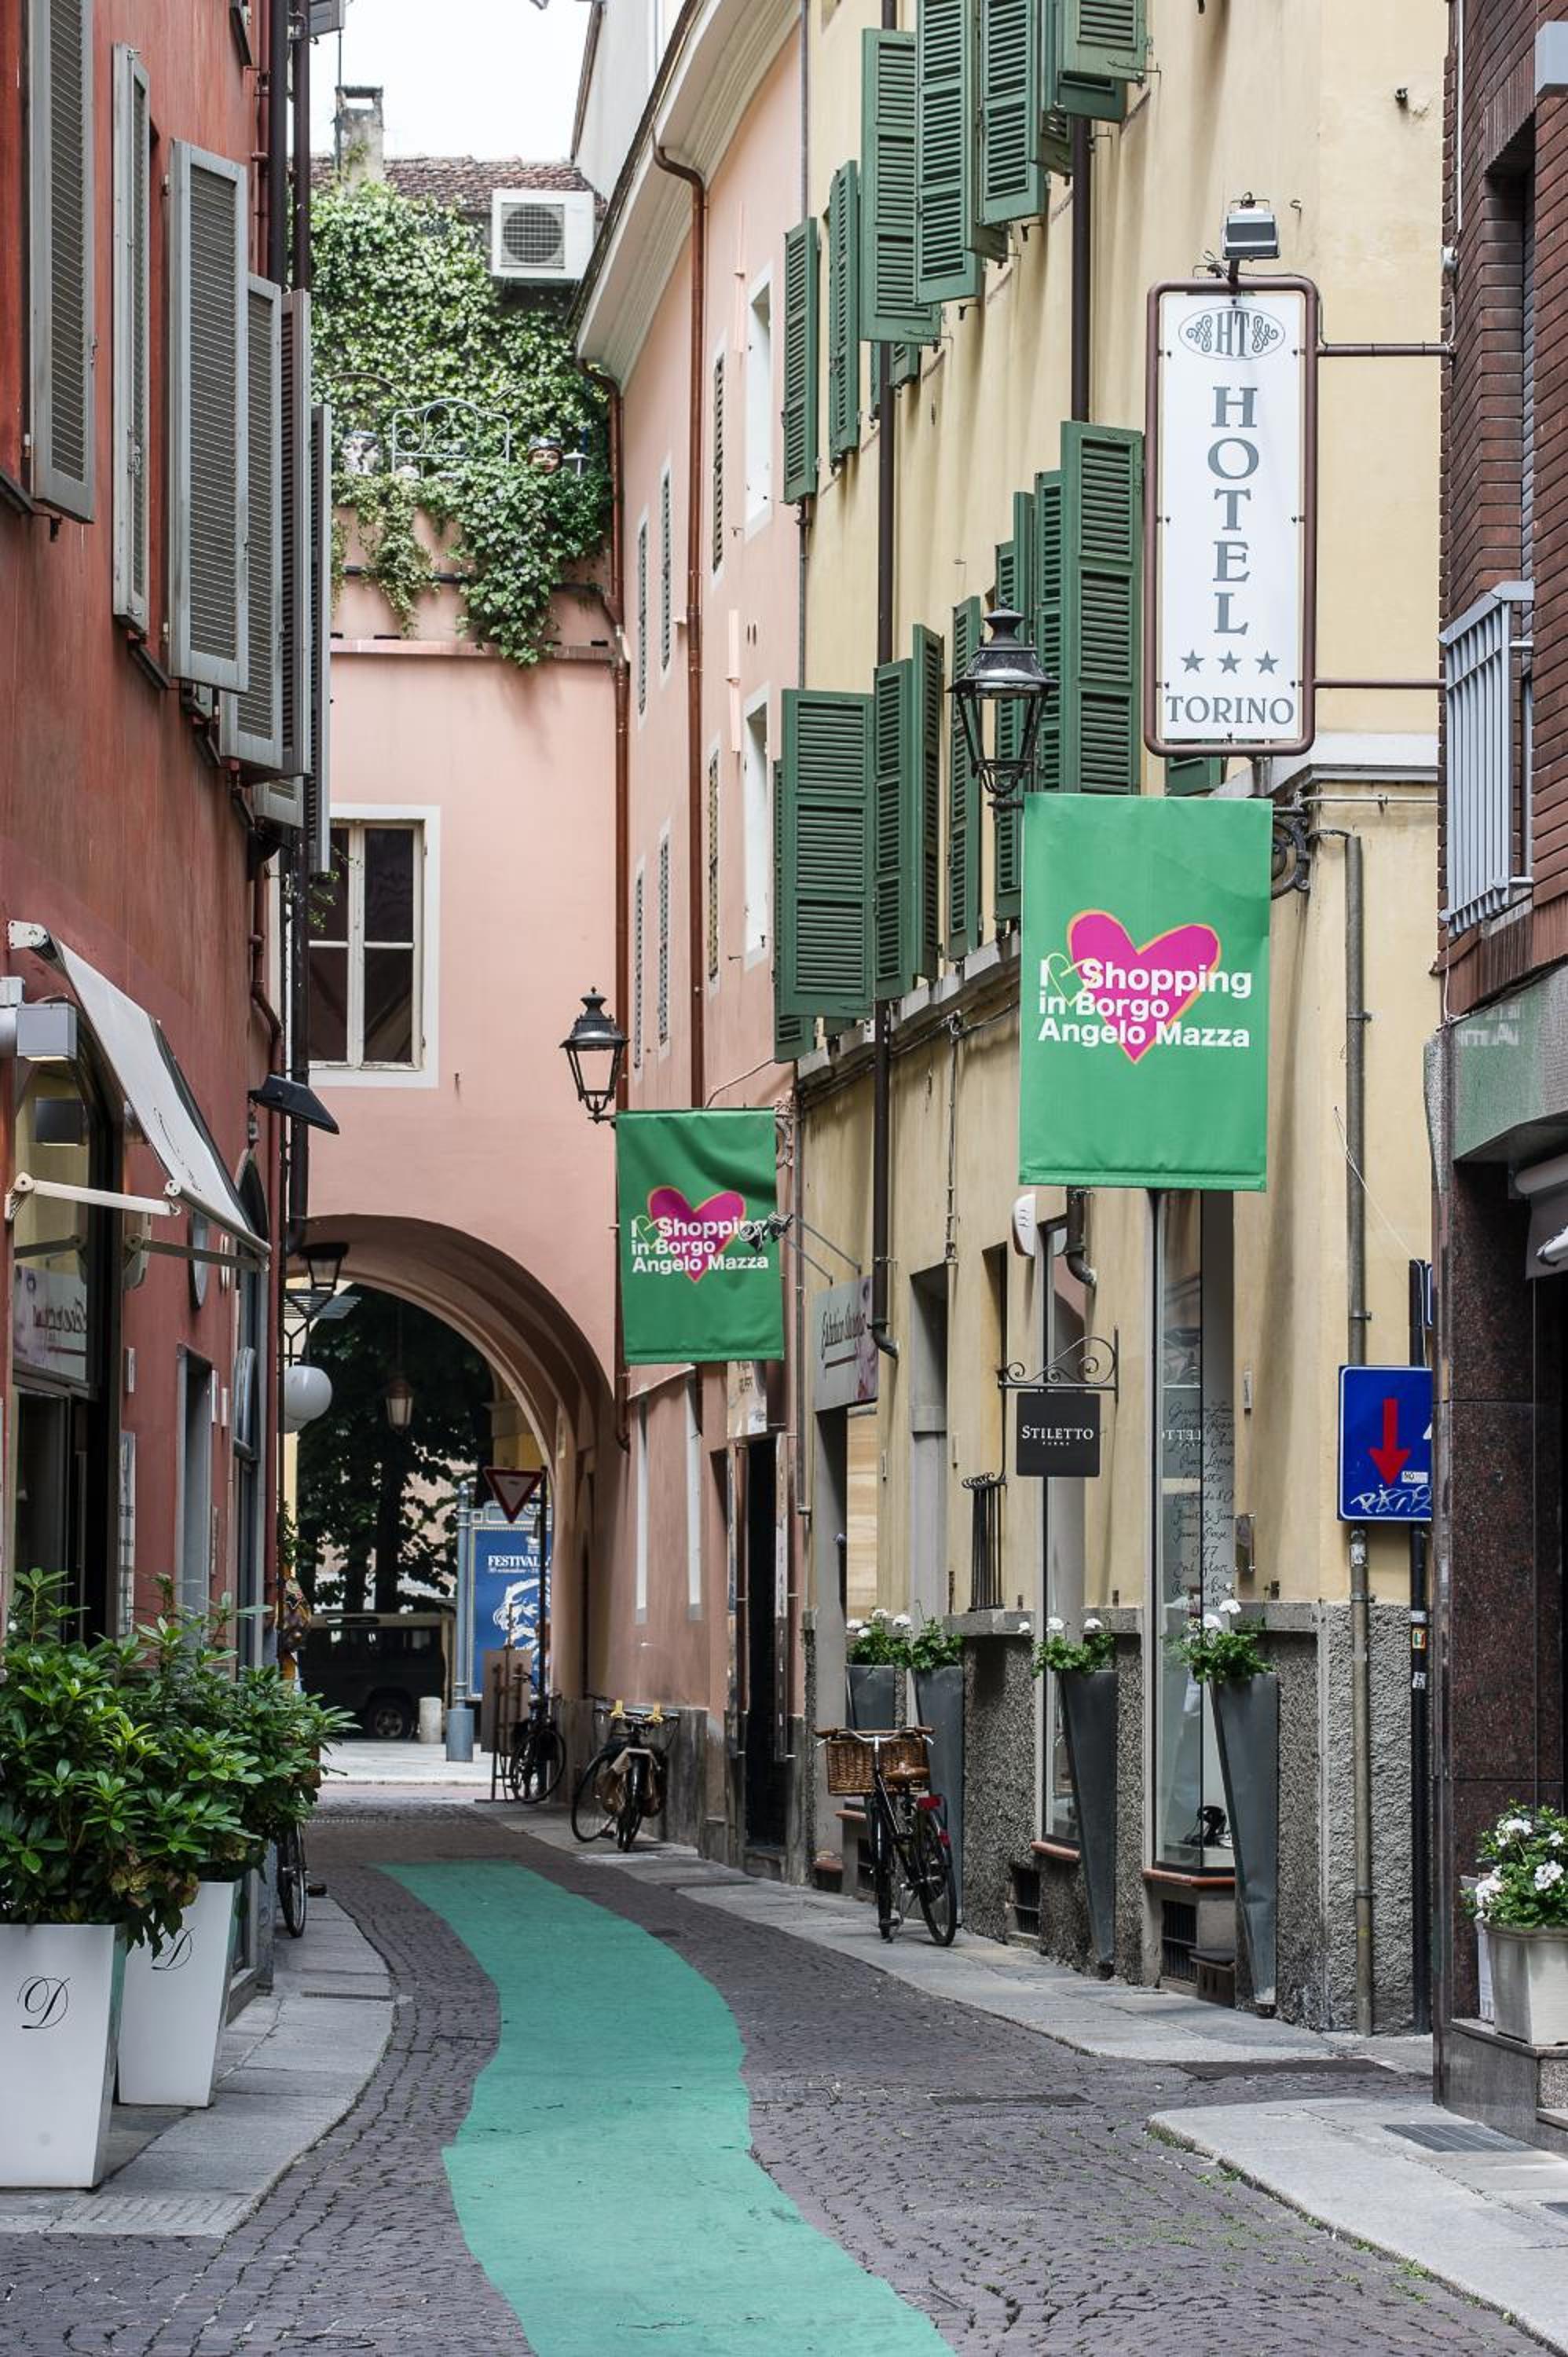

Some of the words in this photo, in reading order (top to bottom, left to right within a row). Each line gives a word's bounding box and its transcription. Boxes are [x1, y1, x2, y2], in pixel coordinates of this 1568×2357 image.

[1207, 386, 1259, 635] HOTEL
[1166, 695, 1295, 725] TORINO
[1039, 959, 1048, 987] I
[1082, 961, 1251, 999] Shopping
[1039, 990, 1065, 1015] in
[1075, 992, 1169, 1022] Borgo
[1038, 1018, 1146, 1047] Angelo
[1156, 1021, 1250, 1047] Mazza
[658, 1217, 768, 1240] Shoppi
[631, 1239, 649, 1255] in
[656, 1239, 716, 1256] Borgo
[632, 1256, 702, 1274] Angelo
[708, 1254, 769, 1270] Mazza
[1021, 1424, 1094, 1440] STILETTO
[488, 1555, 540, 1567] FESTIVAL
[17, 1975, 71, 2029] D
